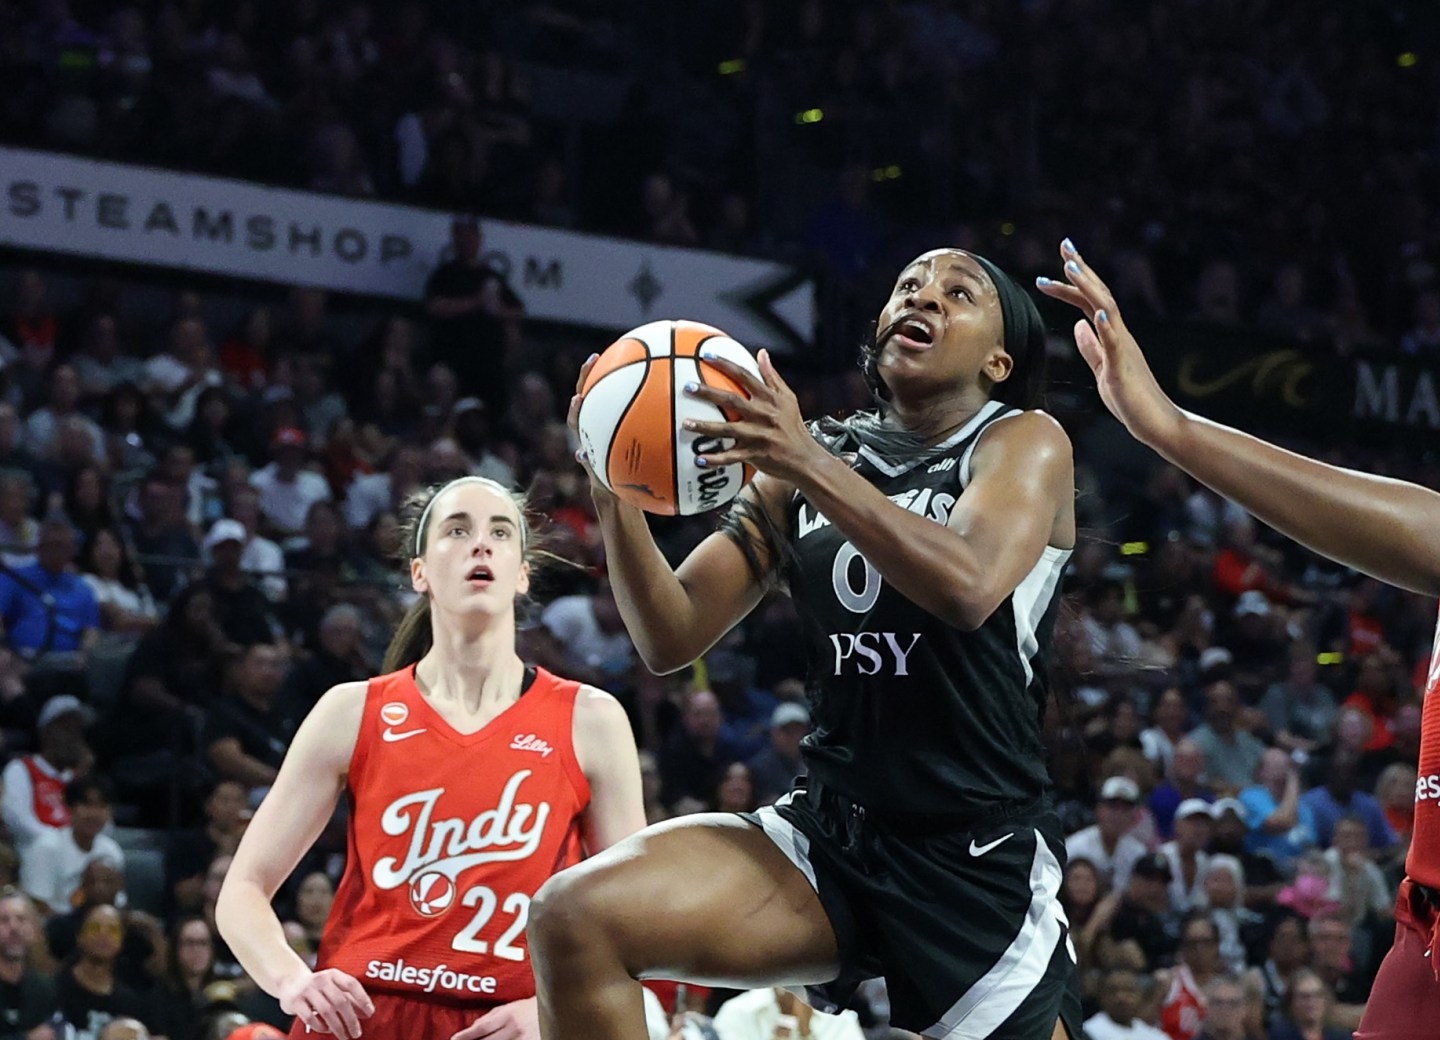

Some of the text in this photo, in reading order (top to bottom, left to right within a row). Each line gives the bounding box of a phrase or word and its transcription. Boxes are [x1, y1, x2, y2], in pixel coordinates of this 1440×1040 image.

[832, 540, 882, 614] 0
[829, 632, 922, 676] PSY
[372, 769, 550, 890] Indy
[451, 885, 532, 962] 22
[365, 958, 498, 994] salesforce
